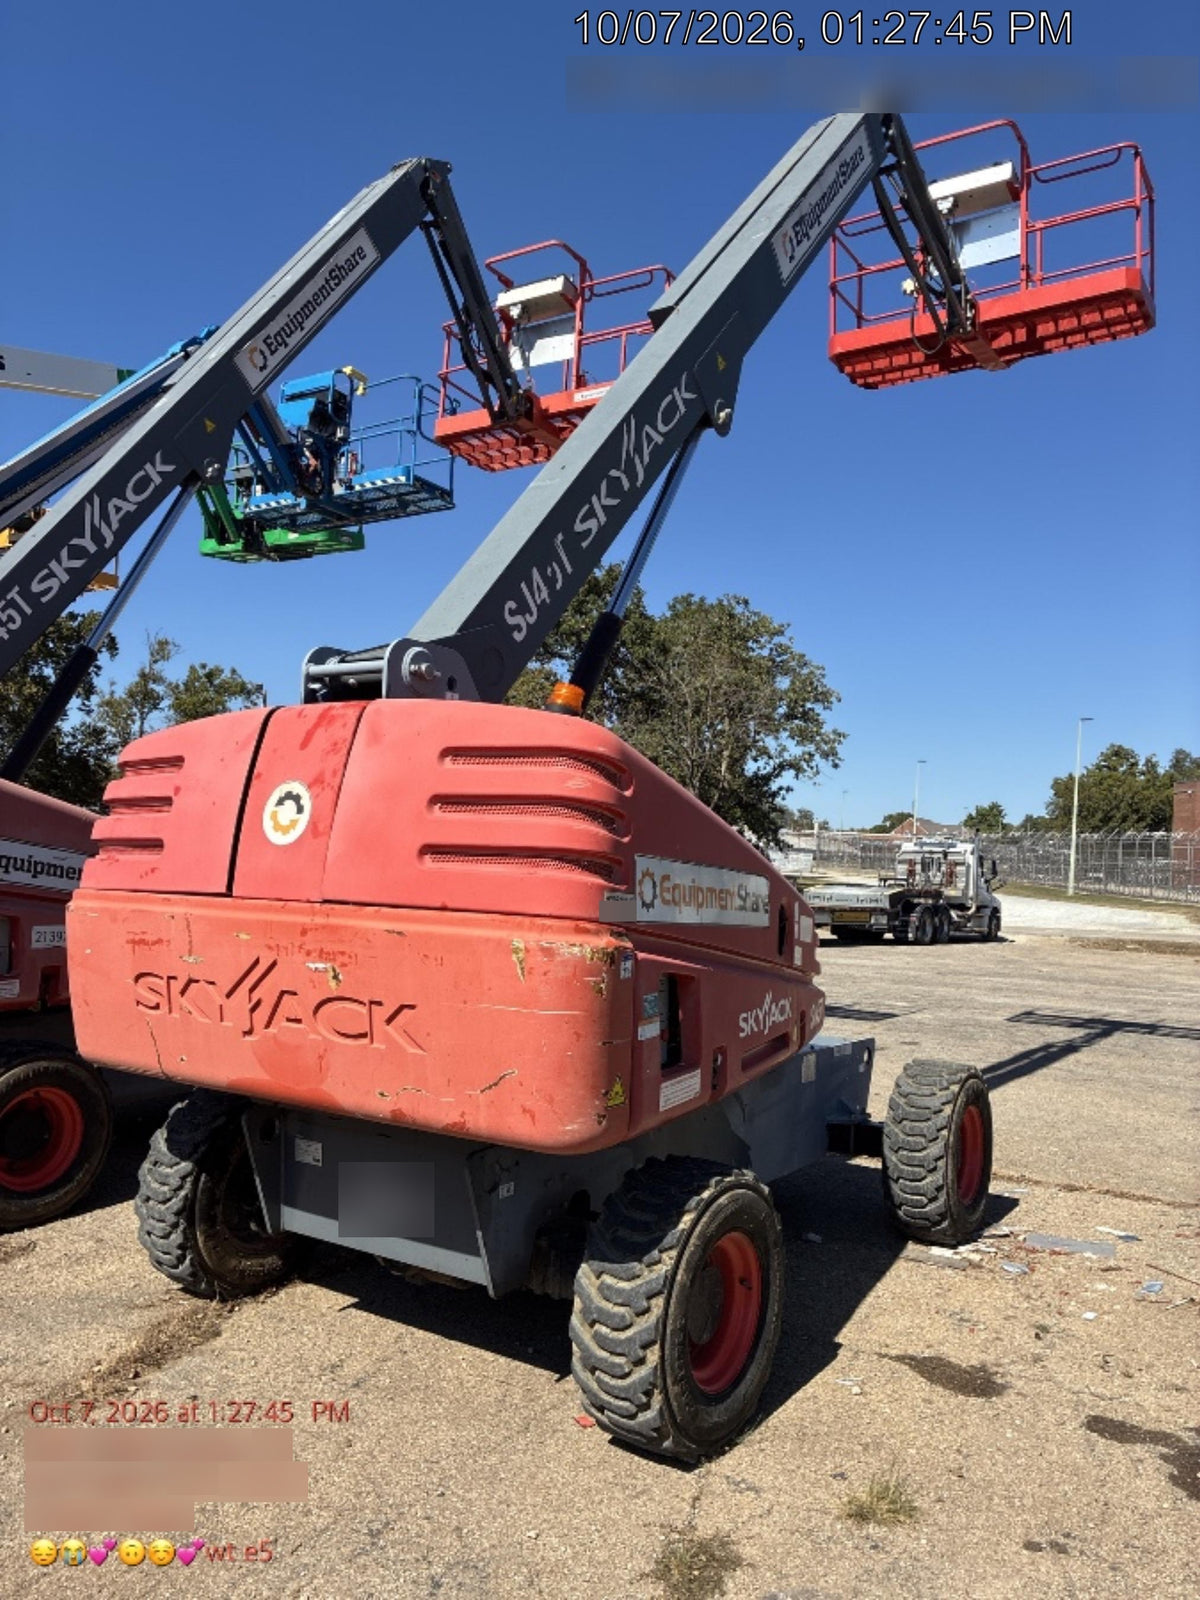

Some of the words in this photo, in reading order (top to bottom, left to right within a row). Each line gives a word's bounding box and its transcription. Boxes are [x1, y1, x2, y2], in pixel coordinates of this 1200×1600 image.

[792, 145, 865, 247] EquipmentShare
[263, 245, 367, 356] EquipmentShare
[574, 371, 698, 549] SKYJACK
[30, 449, 176, 604] SKYJACK
[133, 955, 428, 1055] SKYJACK
[739, 989, 792, 1038] SKYJACK
